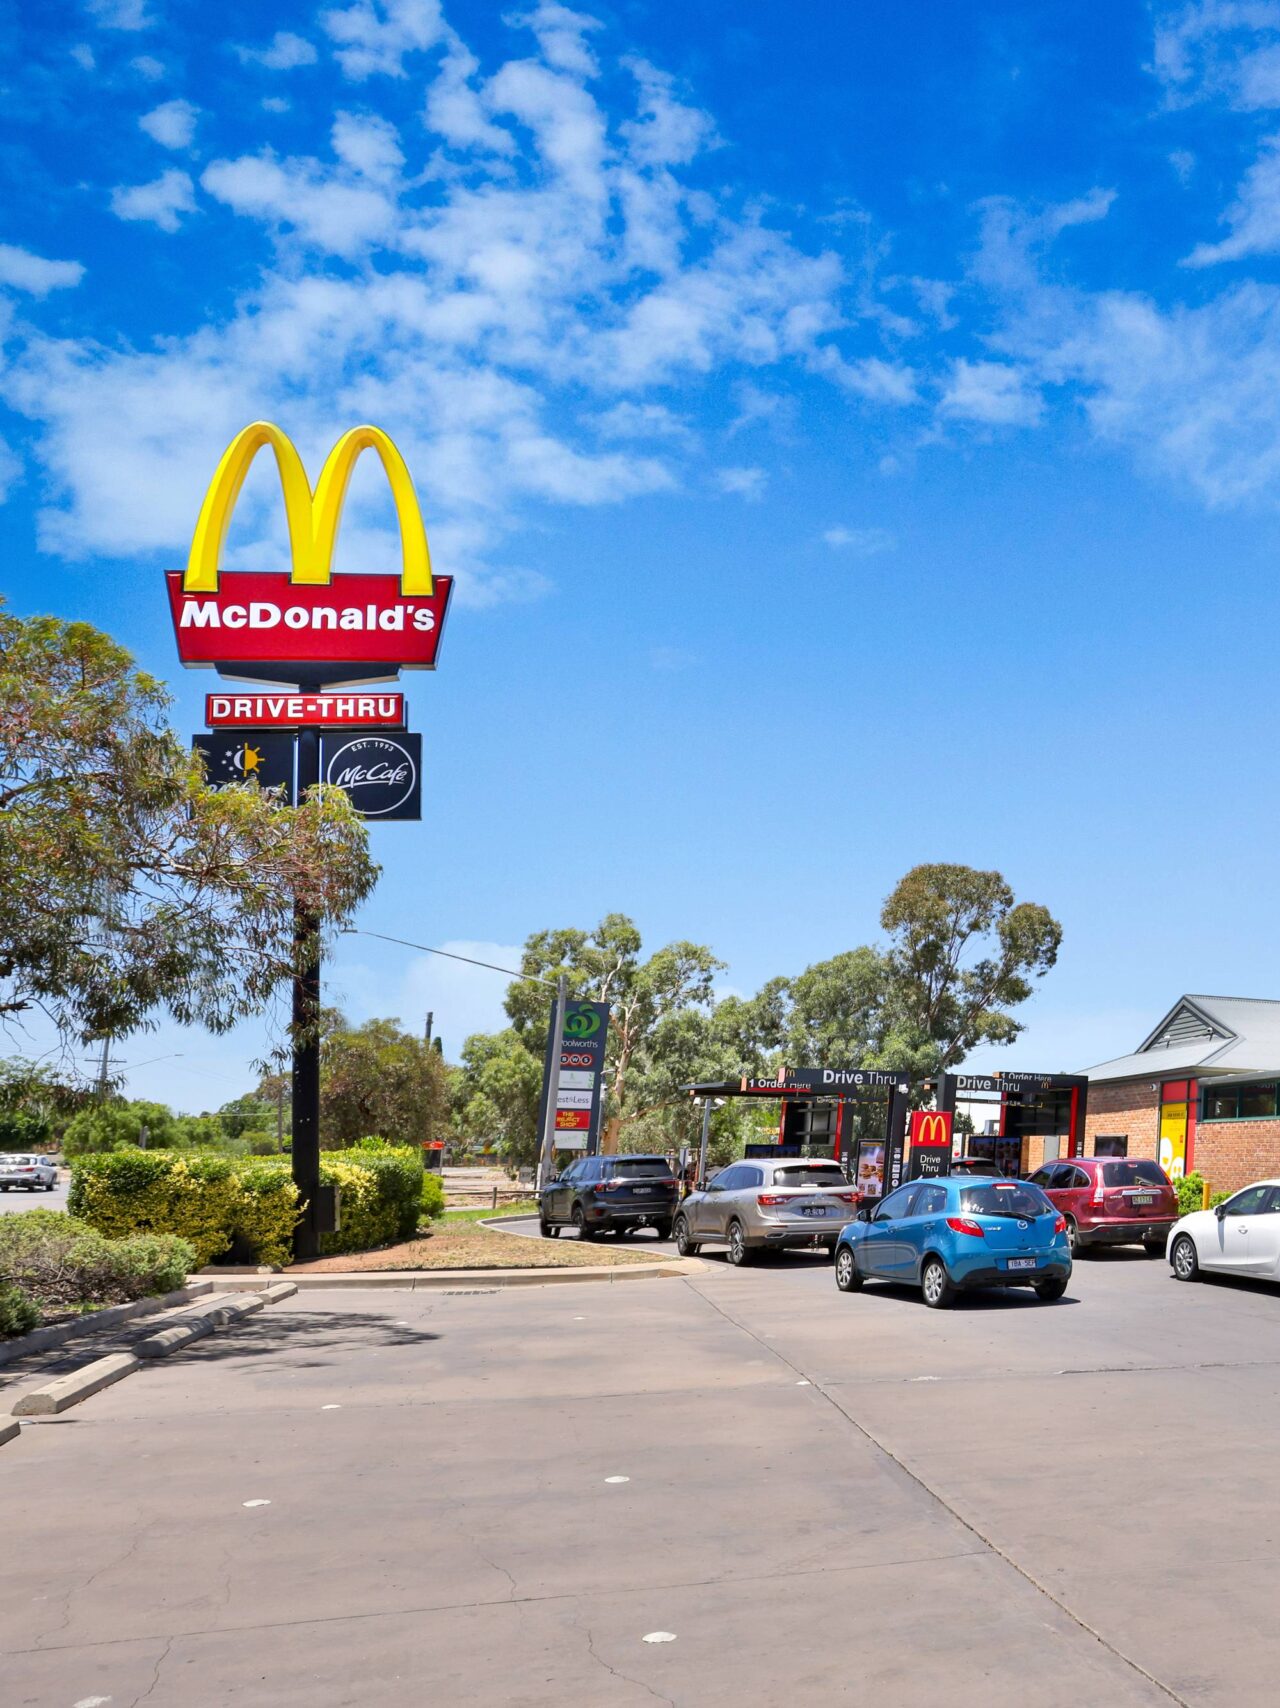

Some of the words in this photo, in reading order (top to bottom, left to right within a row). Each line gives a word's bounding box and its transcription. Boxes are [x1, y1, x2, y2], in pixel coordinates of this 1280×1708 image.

[179, 600, 435, 631] McDonald's
[212, 698, 396, 718] DRIVE-THRU
[351, 742, 370, 752] EST.
[375, 742, 394, 752] 1993
[562, 1040, 599, 1048] oolworths
[823, 1069, 863, 1084] Drive
[867, 1071, 897, 1085] Thru
[758, 1079, 786, 1089] Order
[956, 1075, 992, 1090] Drive
[995, 1078, 1021, 1092] Thru
[920, 1154, 941, 1163] Drive
[921, 1164, 939, 1172] Thru
